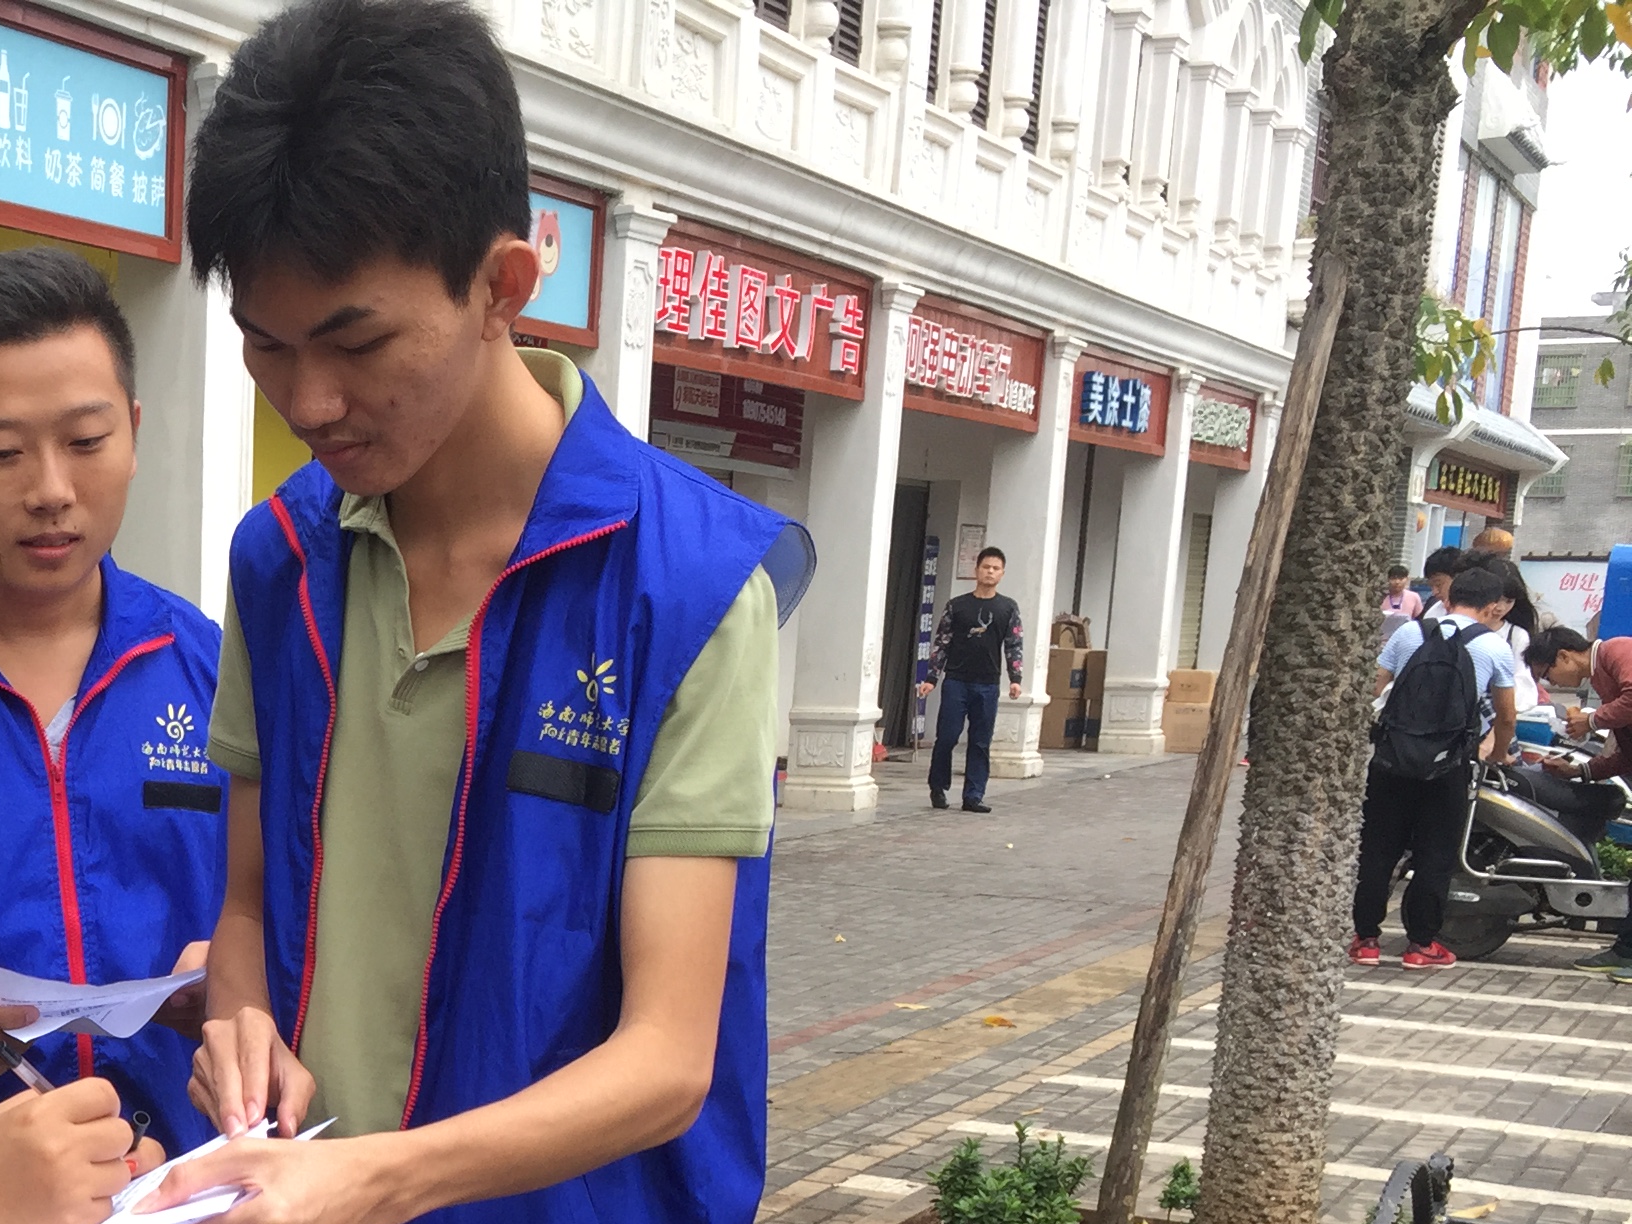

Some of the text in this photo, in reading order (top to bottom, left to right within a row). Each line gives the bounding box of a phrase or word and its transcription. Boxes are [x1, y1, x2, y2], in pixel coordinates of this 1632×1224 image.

[44, 147, 83, 188] 奶茶
[90, 156, 125, 198] 简餐
[132, 171, 166, 207] 披萨
[655, 247, 865, 375] 理佳图文广告
[1085, 369, 1152, 433] 美涂士漆
[1559, 572, 1605, 592] 创建
[537, 700, 630, 737] 海南师大学
